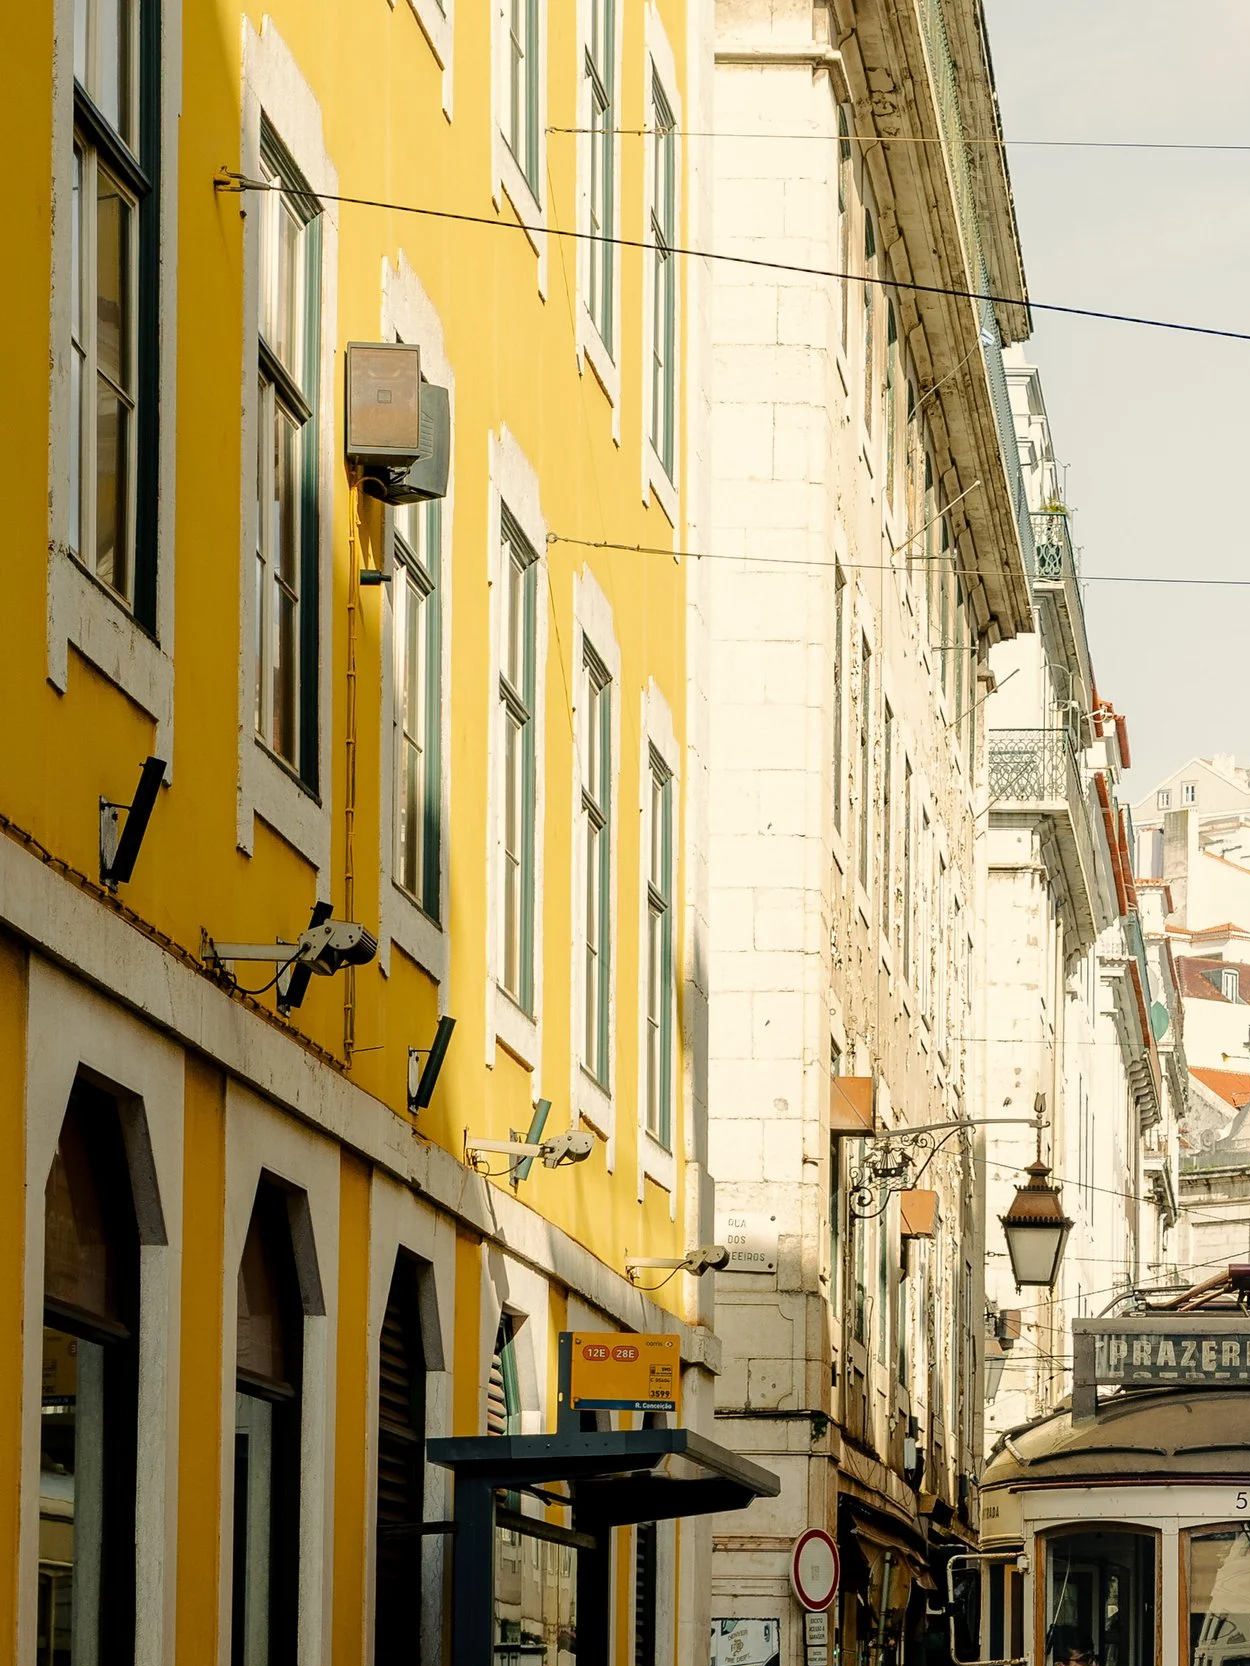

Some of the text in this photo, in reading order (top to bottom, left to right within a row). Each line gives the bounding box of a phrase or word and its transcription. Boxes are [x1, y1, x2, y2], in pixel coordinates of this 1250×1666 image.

[728, 1218, 747, 1228] RUA
[728, 1235, 746, 1244] DOS
[729, 1251, 765, 1262] EEIROS
[587, 1348, 635, 1358] 12E 28E
[650, 1390, 670, 1398] 3599
[642, 1402, 672, 1410] Conceição
